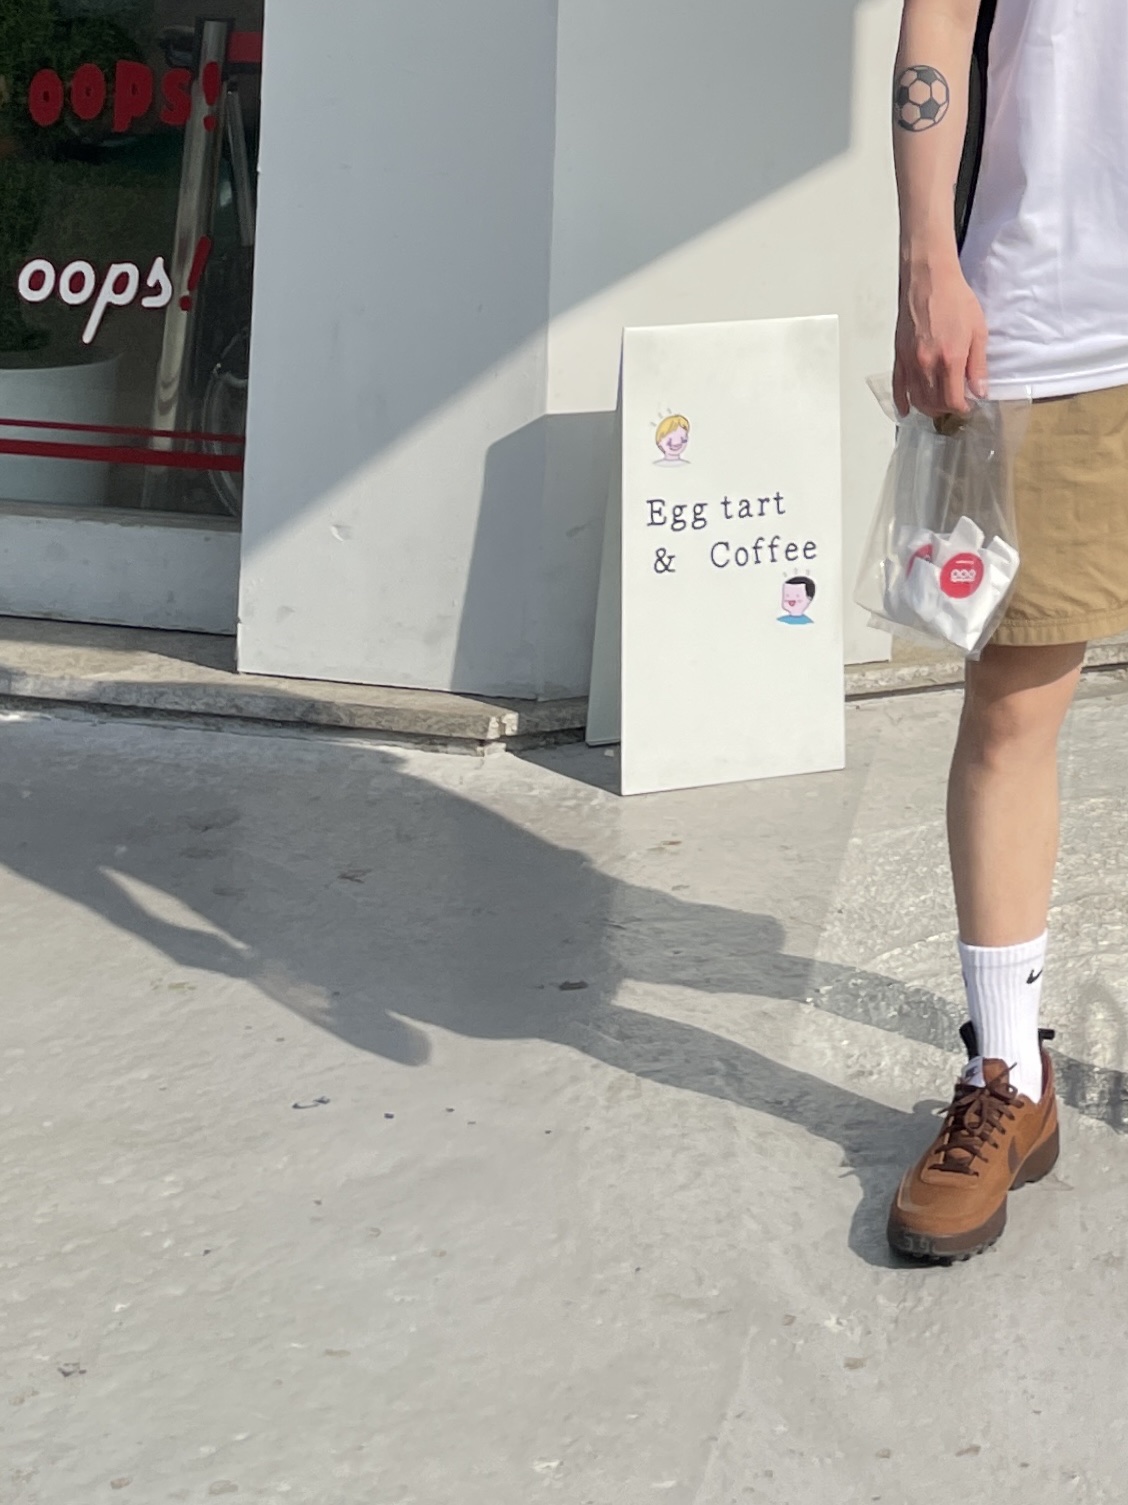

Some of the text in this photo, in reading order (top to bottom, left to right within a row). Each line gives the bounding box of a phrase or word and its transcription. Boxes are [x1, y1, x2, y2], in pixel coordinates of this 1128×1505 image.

[28, 60, 222, 134] oops!
[16, 236, 211, 345] oops!
[646, 491, 786, 532] Egg tart
[653, 536, 818, 575] & Coffee
